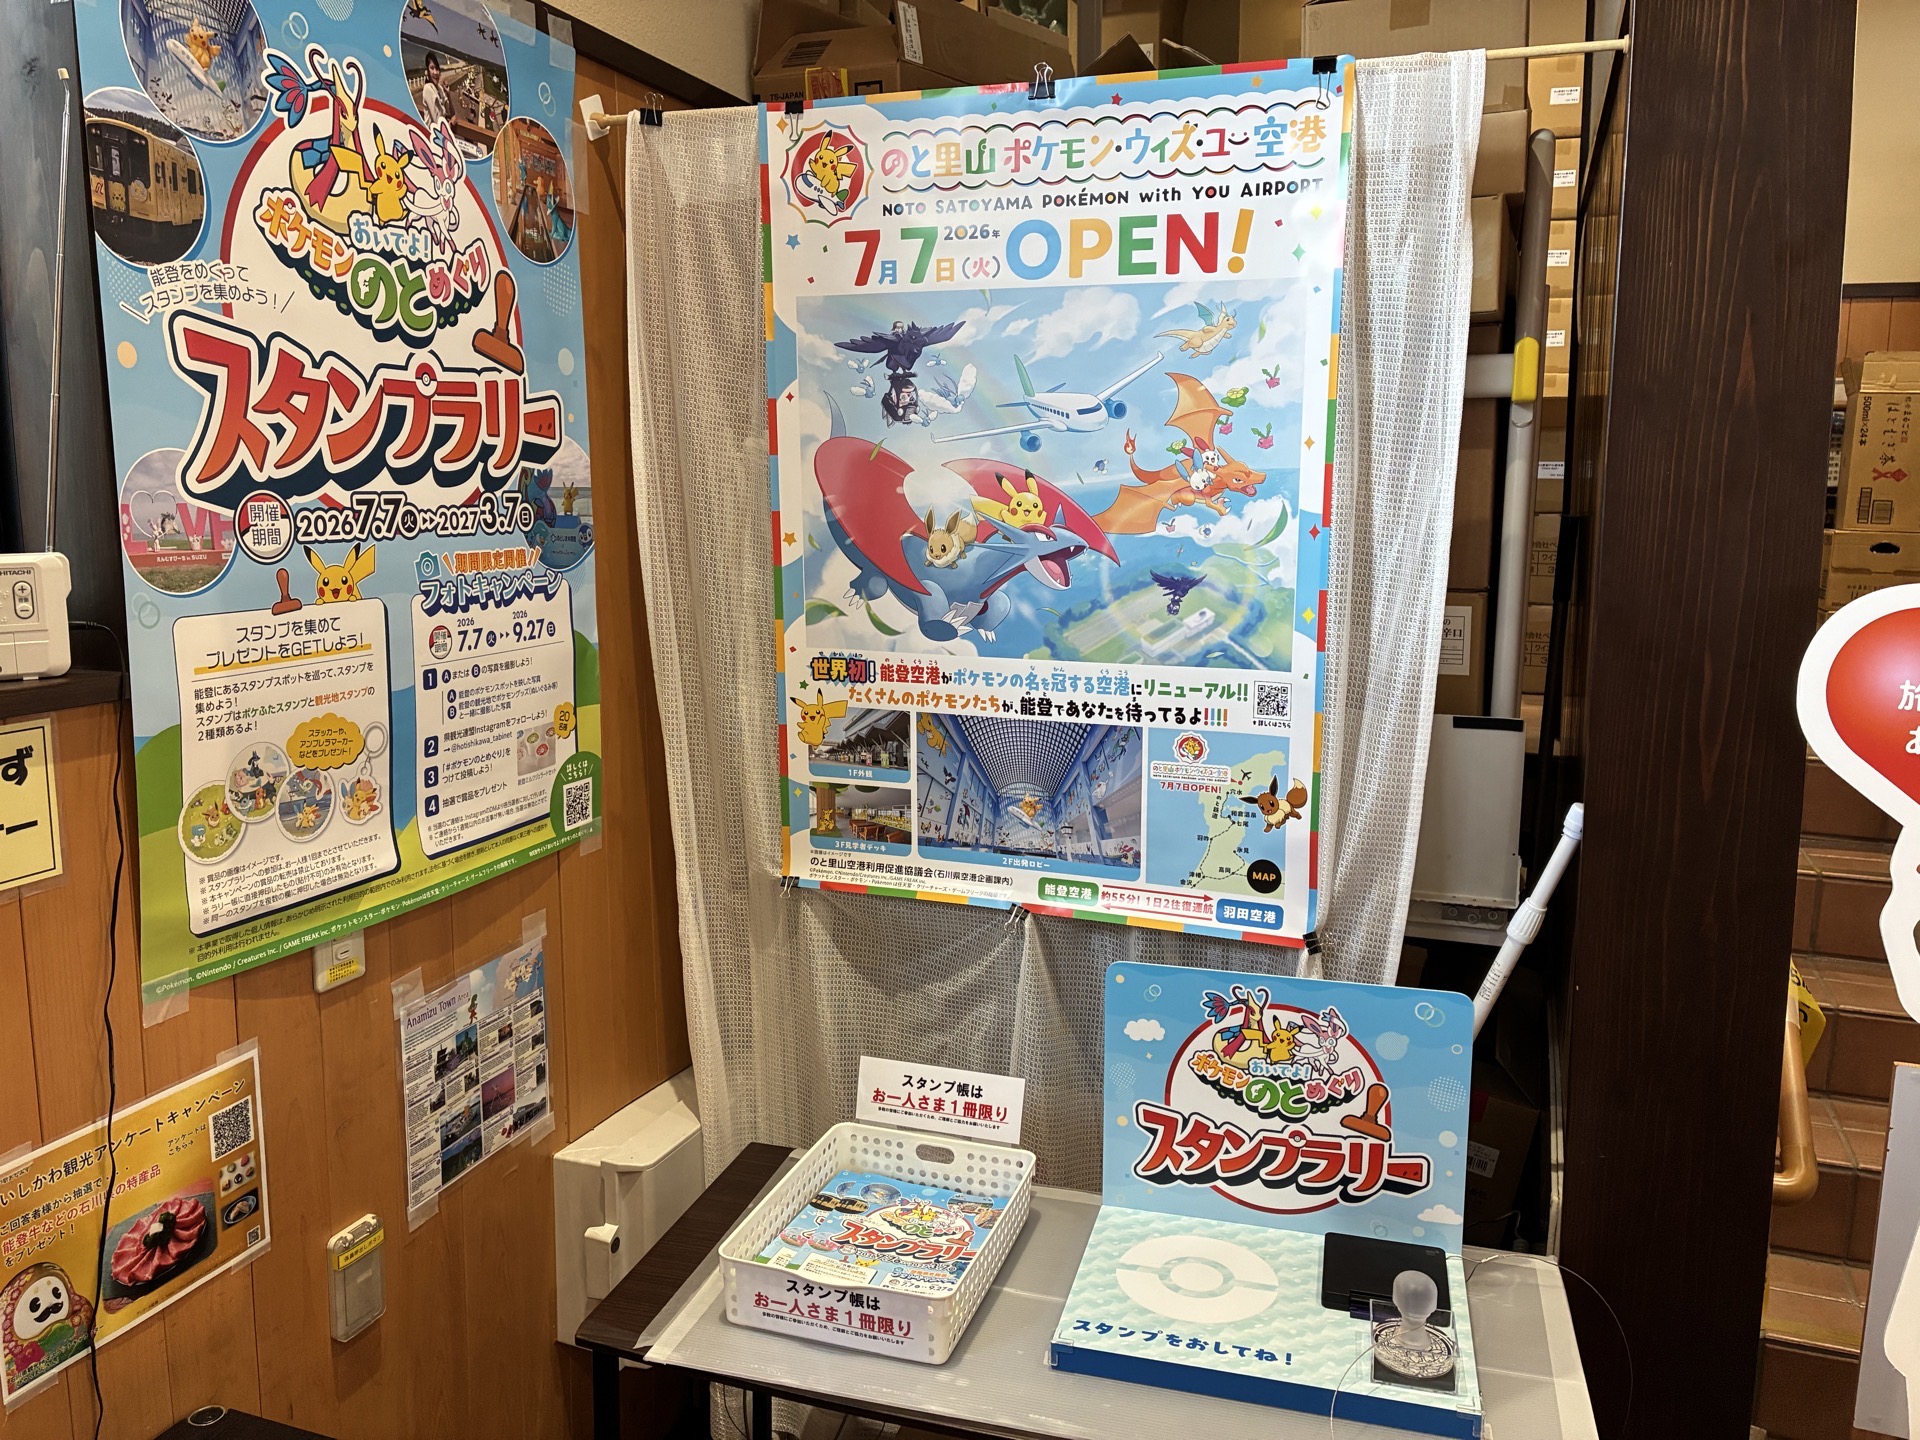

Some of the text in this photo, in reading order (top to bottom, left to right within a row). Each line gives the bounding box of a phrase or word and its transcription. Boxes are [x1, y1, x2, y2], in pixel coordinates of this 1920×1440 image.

[770, 92, 804, 101] TS-JAPAN
[882, 178, 1324, 217] NOTO SATOYAMA POKÉMON with YOU AIRPORT
[1006, 208, 1254, 283] OPEN!
[150, 263, 249, 287] 能登をめぐって
[142, 283, 278, 314] スタンプを集めよう!
[182, 327, 558, 484] スタンプラリー
[250, 504, 281, 522] 開催
[252, 528, 282, 547] 期間
[191, 554, 208, 562] SUZU
[421, 571, 563, 610] フォトキャンペーン
[236, 616, 342, 644] スタンプを集めて
[457, 610, 528, 627] 2026 2026
[457, 628, 483, 652] 7.7
[512, 619, 545, 643] 9.27
[206, 633, 364, 670] プレゼントをGETしよう!
[810, 657, 877, 684] 世界初!
[195, 697, 239, 714] 集めよう!
[559, 710, 570, 721] 20
[197, 721, 258, 742] 2種類あるよ!
[1257, 720, 1291, 729] 詳しくはこちら
[848, 768, 873, 778] 1F外観
[1252, 872, 1276, 882] MAP
[1044, 884, 1092, 900] 能登空港
[1223, 905, 1277, 924] 羽田空港
[283, 938, 301, 951] GAME
[301, 931, 320, 945] FREAK
[406, 1007, 438, 1030] Anamizu
[438, 996, 457, 1012] Town
[1249, 1059, 1310, 1080] おいでよ!
[902, 1074, 983, 1099] スタンプ帳は
[872, 1087, 1008, 1122] お一人さま1冊限り
[168, 1123, 206, 1147] アンケートは
[1140, 1109, 1424, 1192] スタンプラリー
[5, 1223, 76, 1268] をプレゼント!
[837, 1220, 977, 1262] スタンプラリー
[786, 1279, 881, 1311] スタンプ帳は
[754, 1291, 911, 1337] お一人さま1冊限り
[1073, 1318, 1293, 1366] スタンプをおしてね!
